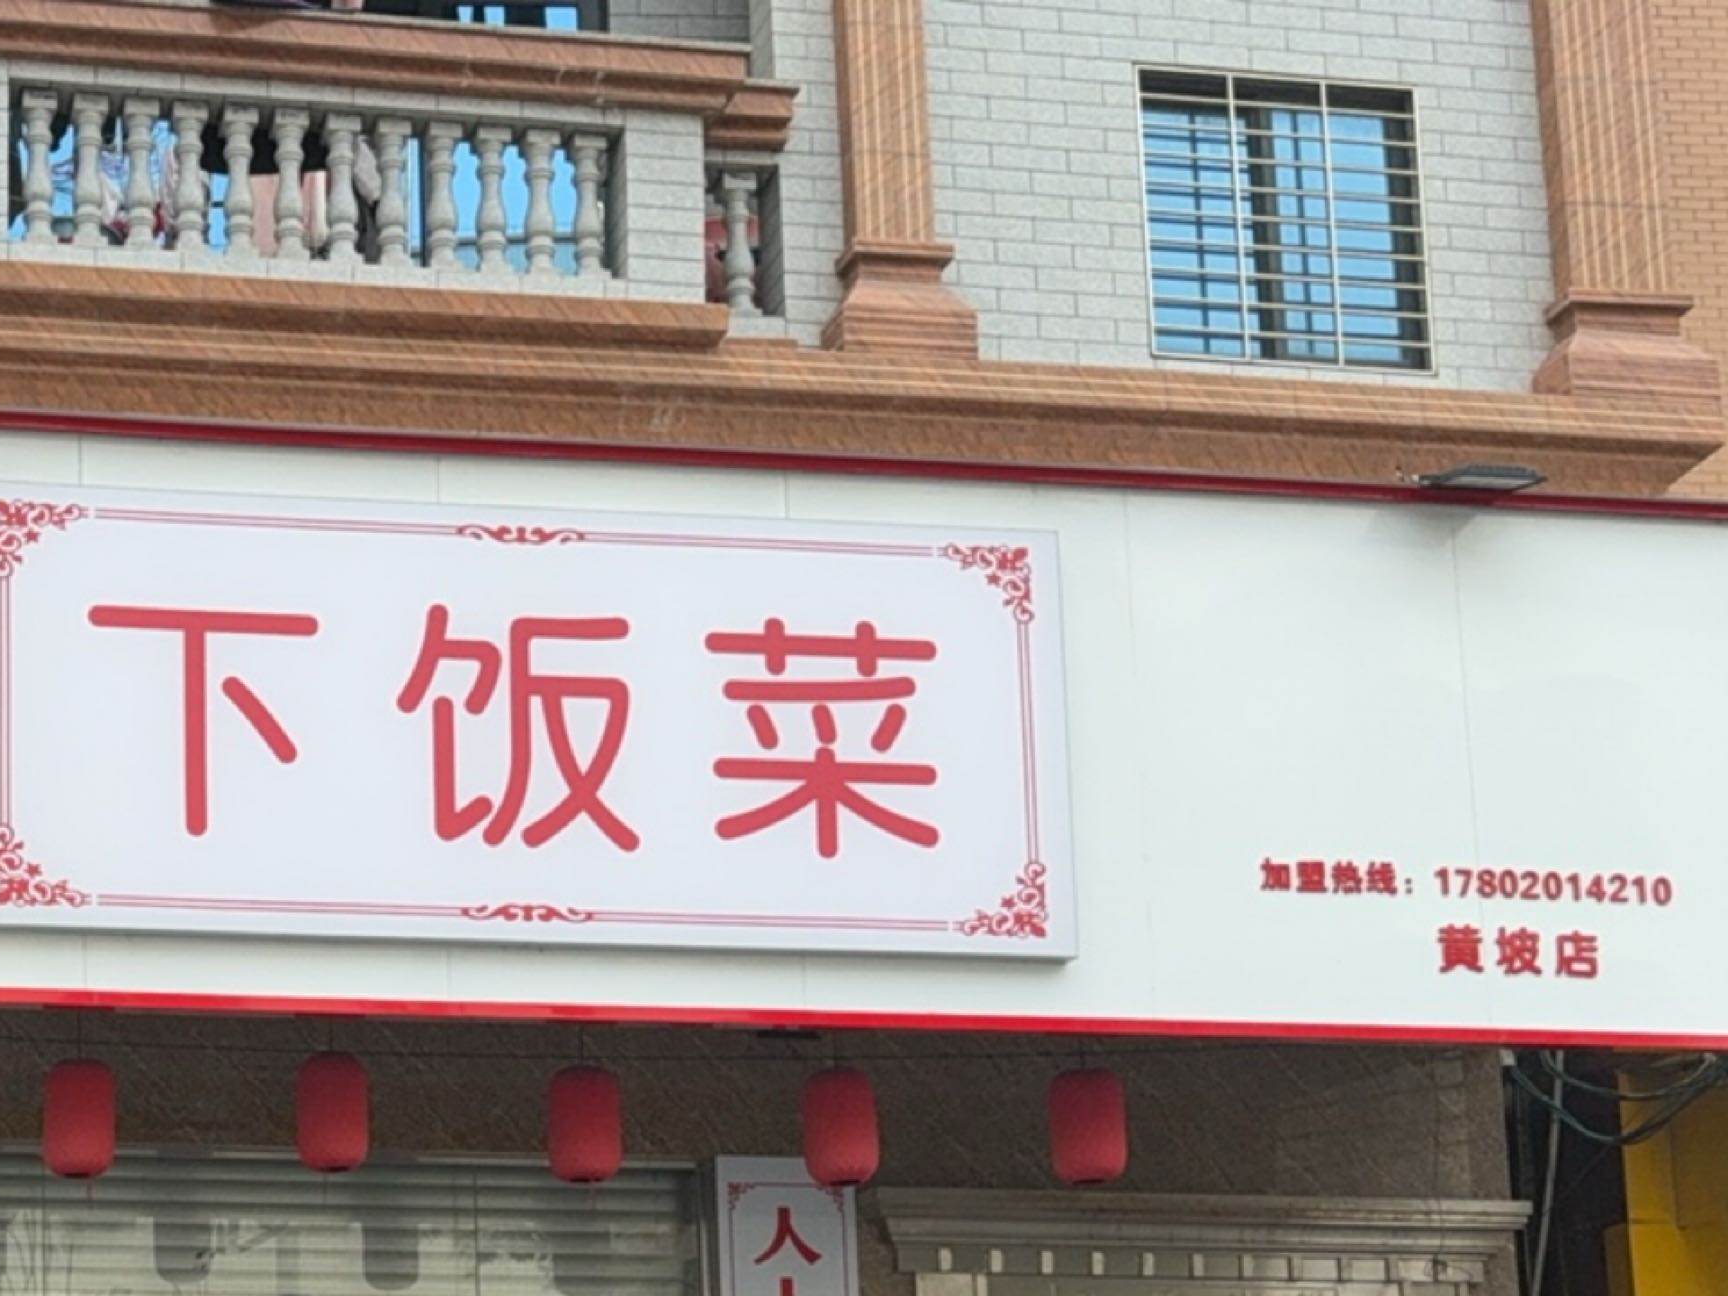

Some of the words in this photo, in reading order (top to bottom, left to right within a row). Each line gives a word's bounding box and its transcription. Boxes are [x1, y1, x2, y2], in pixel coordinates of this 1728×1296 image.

[87, 602, 940, 859] 下饭菜
[1437, 924, 1599, 979] 黄坡店
